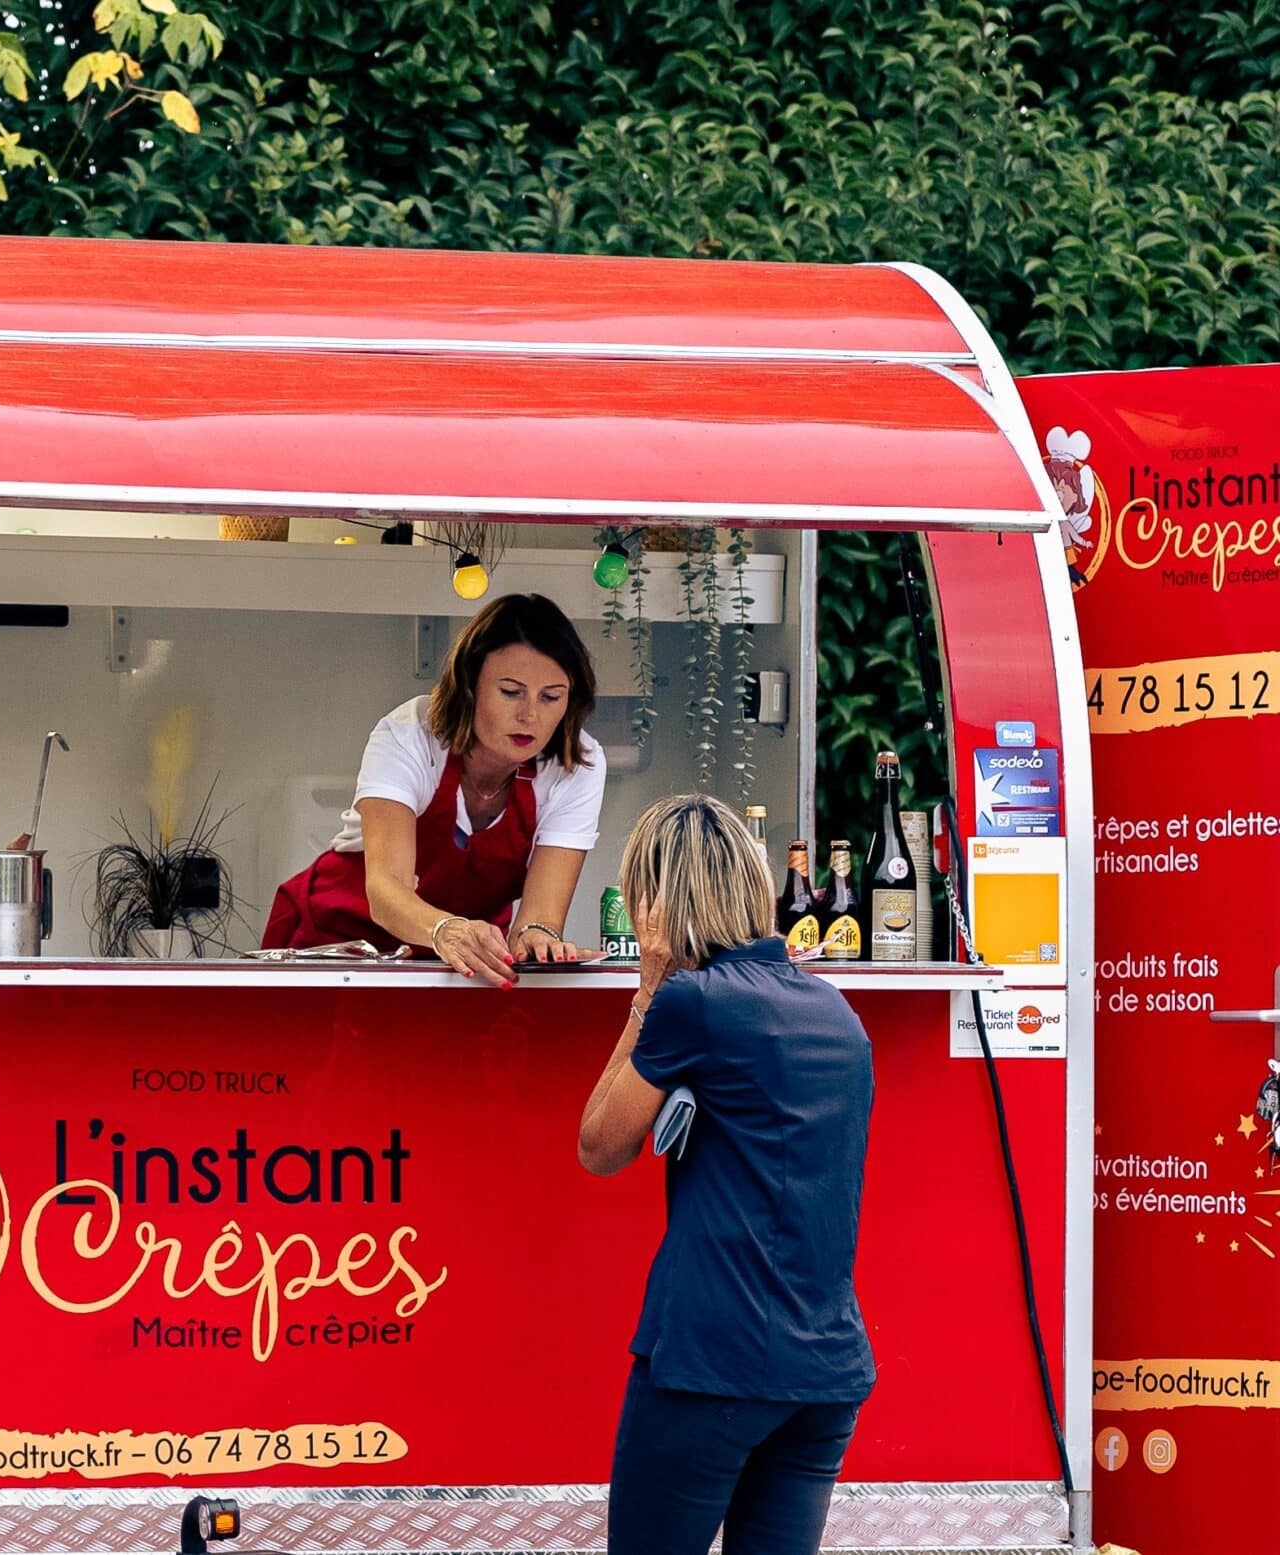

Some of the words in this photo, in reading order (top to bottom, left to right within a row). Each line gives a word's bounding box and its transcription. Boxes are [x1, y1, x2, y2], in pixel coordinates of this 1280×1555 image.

[1171, 448, 1202, 461] FOOD
[1208, 445, 1239, 459] TRUCK
[1161, 569, 1209, 587] Maître
[1087, 674, 1104, 715] 4
[1118, 675, 1160, 714] 78
[1174, 673, 1215, 711] 15
[1229, 670, 1269, 709] 12
[989, 753, 1043, 768] sodexo
[1095, 816, 1160, 845] rêpes
[1166, 814, 1189, 838] et
[1095, 845, 1199, 873] rtisanales
[1094, 952, 1166, 978] roduits
[1173, 952, 1219, 978] frais
[1108, 986, 1138, 1012] de
[1145, 989, 1214, 1012] saison
[957, 1019, 1013, 1030] Resurant
[984, 1009, 1013, 1020] Ticket
[1017, 1013, 1061, 1025] Edenred
[132, 1068, 206, 1093] FOOD
[216, 1070, 290, 1095] TRUCK
[56, 1118, 411, 1205] L'instant
[1095, 1153, 1208, 1179] ivatisation
[1115, 1187, 1247, 1215] événements
[20, 1179, 448, 1362] Crêpes
[132, 1317, 242, 1349] Maître
[285, 1315, 415, 1349] crêpier
[1093, 1364, 1271, 1398] pe-foodtruck.fr
[154, 1437, 193, 1466] 06
[204, 1434, 242, 1463] 74
[254, 1433, 292, 1461] 78
[304, 1432, 341, 1460] 15
[352, 1430, 389, 1458] 12
